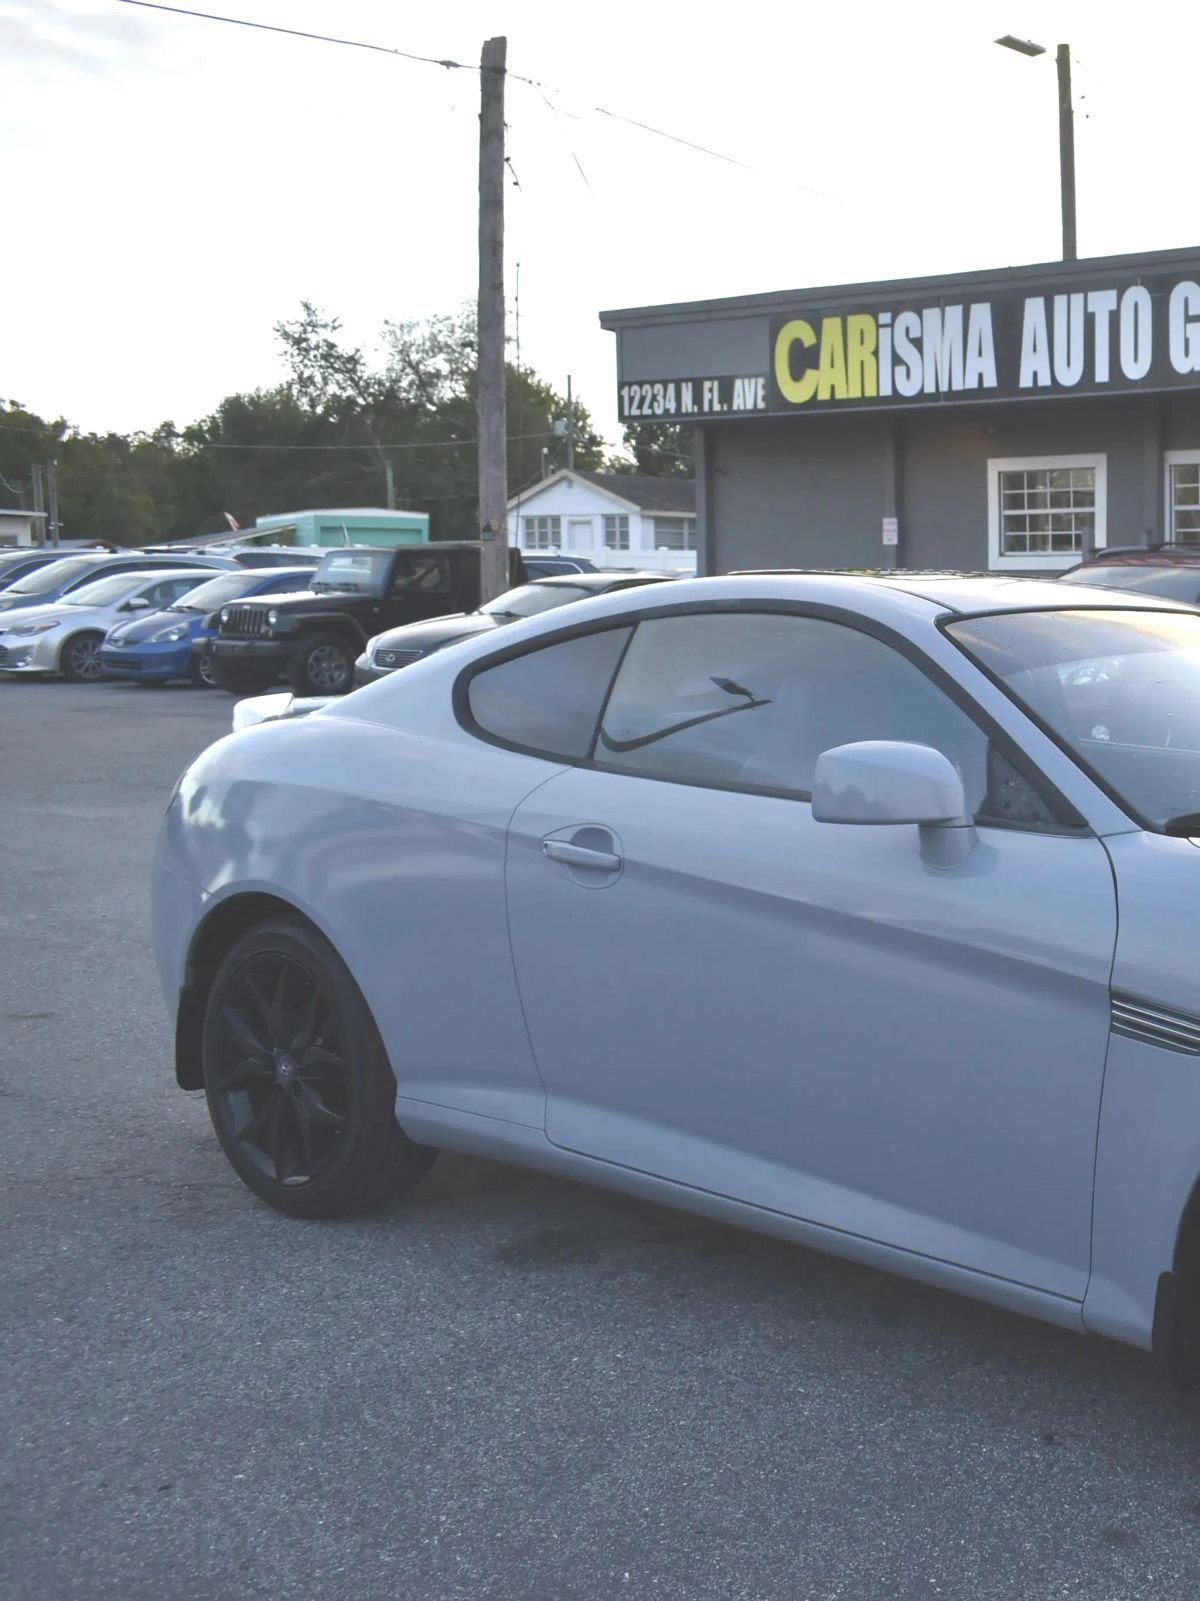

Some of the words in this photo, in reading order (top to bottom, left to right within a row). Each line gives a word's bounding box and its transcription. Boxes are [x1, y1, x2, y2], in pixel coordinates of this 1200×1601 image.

[1018, 285, 1153, 388] AUTO
[620, 382, 677, 416] 12234
[681, 381, 699, 413] N.
[703, 380, 728, 412] FL.
[732, 377, 766, 411] AVE
